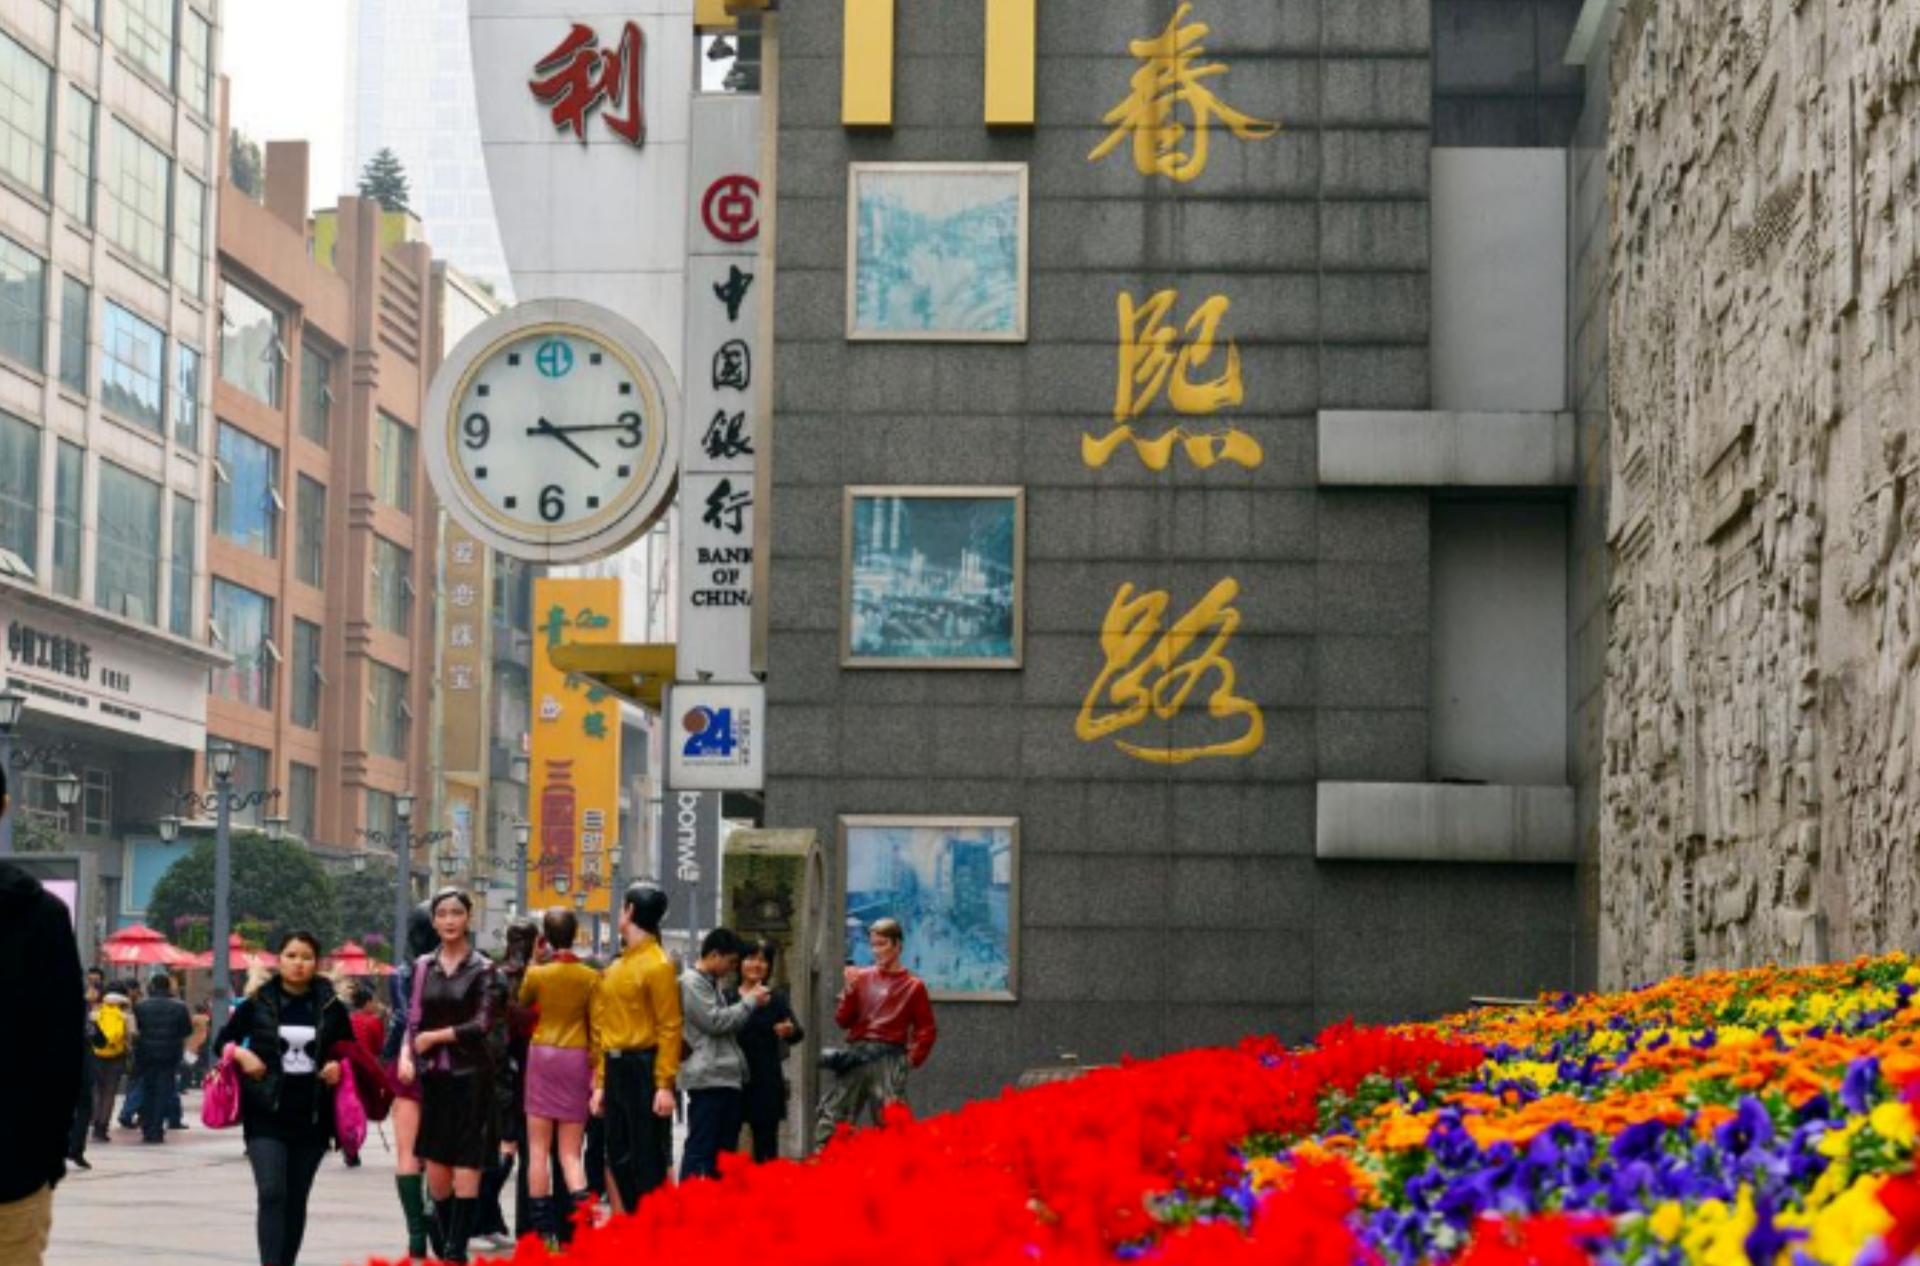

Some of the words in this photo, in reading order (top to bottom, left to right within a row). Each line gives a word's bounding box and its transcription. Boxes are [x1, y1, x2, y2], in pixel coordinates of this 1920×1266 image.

[528, 20, 646, 148] 利
[1075, 2, 1282, 763] 春熙路
[463, 412, 491, 450] 9
[615, 410, 643, 449] 3
[538, 484, 566, 522] 6
[712, 568, 740, 585] OF
[681, 705, 737, 757] 24
